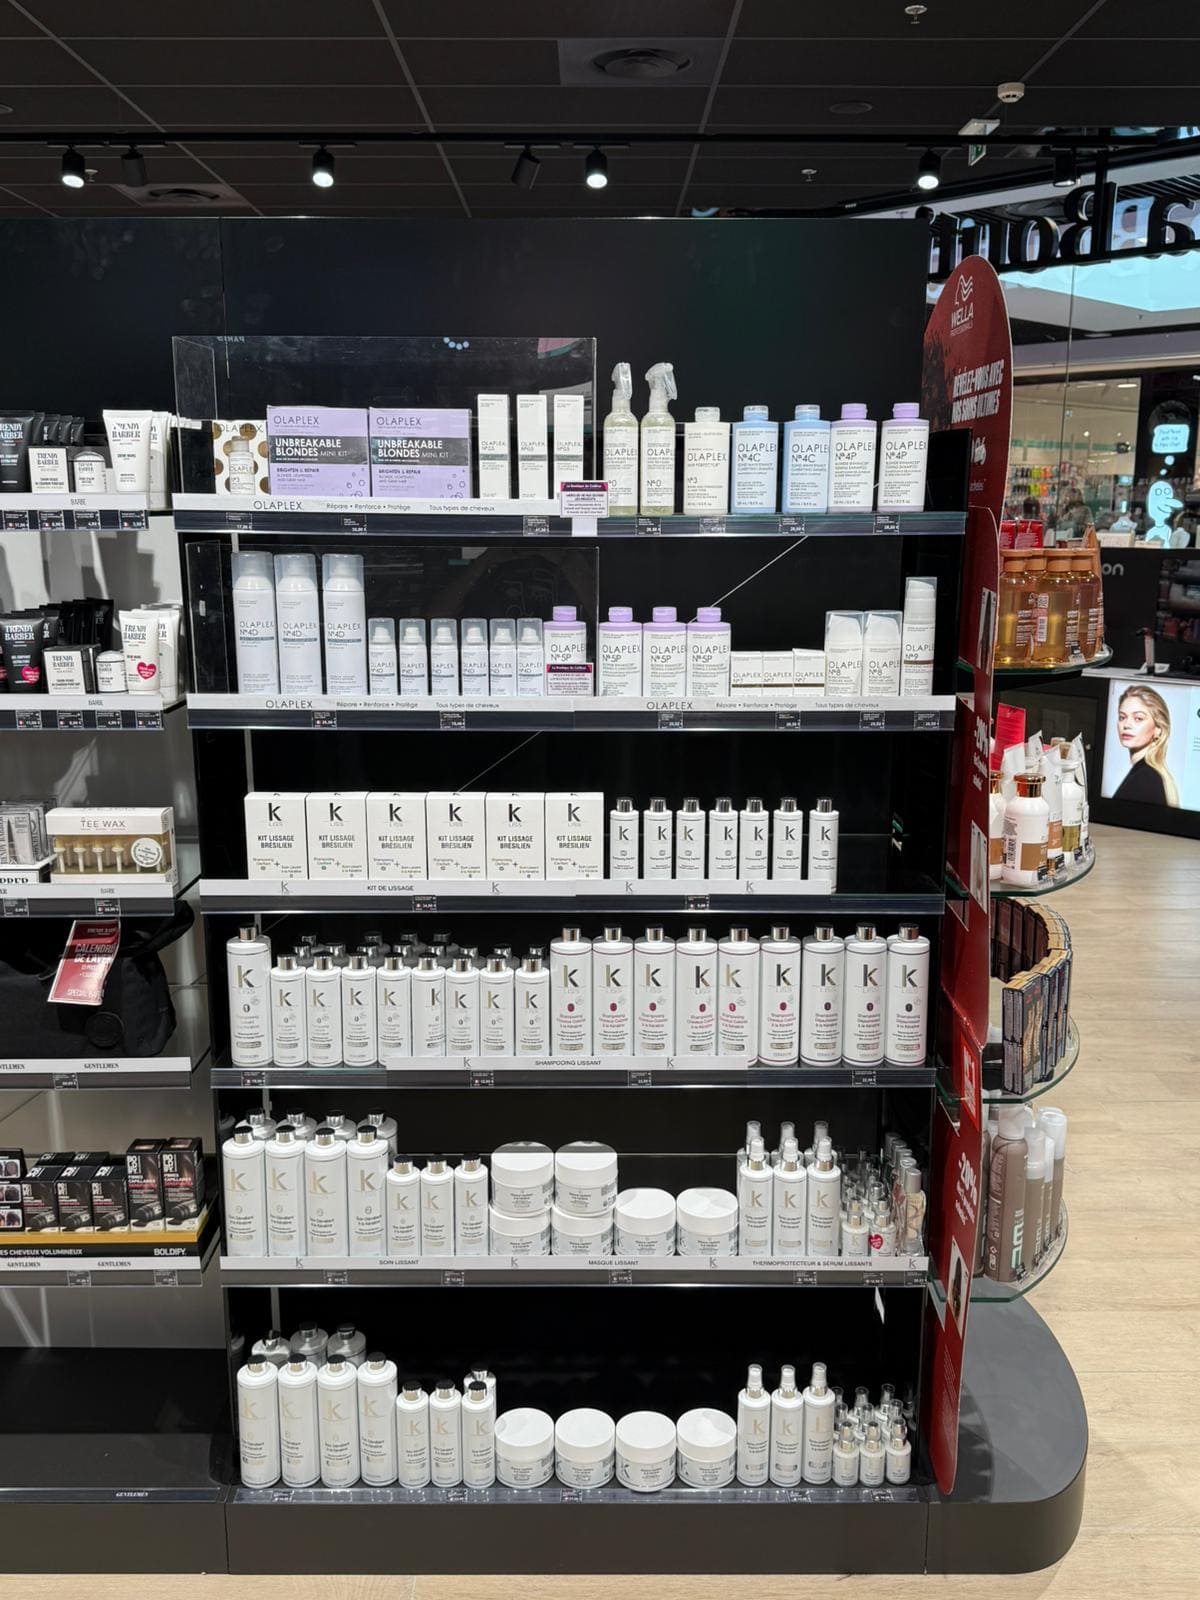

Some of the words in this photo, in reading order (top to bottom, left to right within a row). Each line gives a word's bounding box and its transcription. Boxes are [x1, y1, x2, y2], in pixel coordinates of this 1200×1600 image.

[951, 303, 974, 328] WELLA
[273, 415, 320, 426] OLAPLEX
[376, 416, 423, 427] OLAPLEX
[0, 422, 24, 431] RENDY
[112, 431, 141, 439] BARBER
[275, 437, 342, 449] UNBREAKABLE
[377, 439, 444, 450] UNBREAKABLE
[275, 447, 319, 458] BLONDES
[377, 448, 421, 459] BLONDES
[687, 452, 727, 462] OLAPLEX
[253, 500, 303, 511] OLAPLEX
[326, 503, 349, 511] Répare
[354, 502, 382, 510] Renforce
[387, 503, 411, 512] Protège
[5, 624, 34, 633] TRENDY
[123, 624, 147, 633] TRENDY
[327, 623, 361, 631] OLAPLEX
[5, 632, 35, 641] BARBER
[123, 632, 147, 641] BARBER
[265, 699, 313, 709] OLAPLEX
[336, 702, 358, 710] Répare
[395, 702, 419, 710] Protège
[646, 701, 693, 711] OLAPLEX
[80, 820, 100, 828] TEE
[101, 820, 126, 828] WAX
[257, 834, 268, 842] KIT
[318, 834, 329, 842] KIT
[329, 834, 356, 842] LISSAGE
[40, 1248, 83, 1256] VOLUMINEUX
[154, 1248, 187, 1256] BOLDIFY
